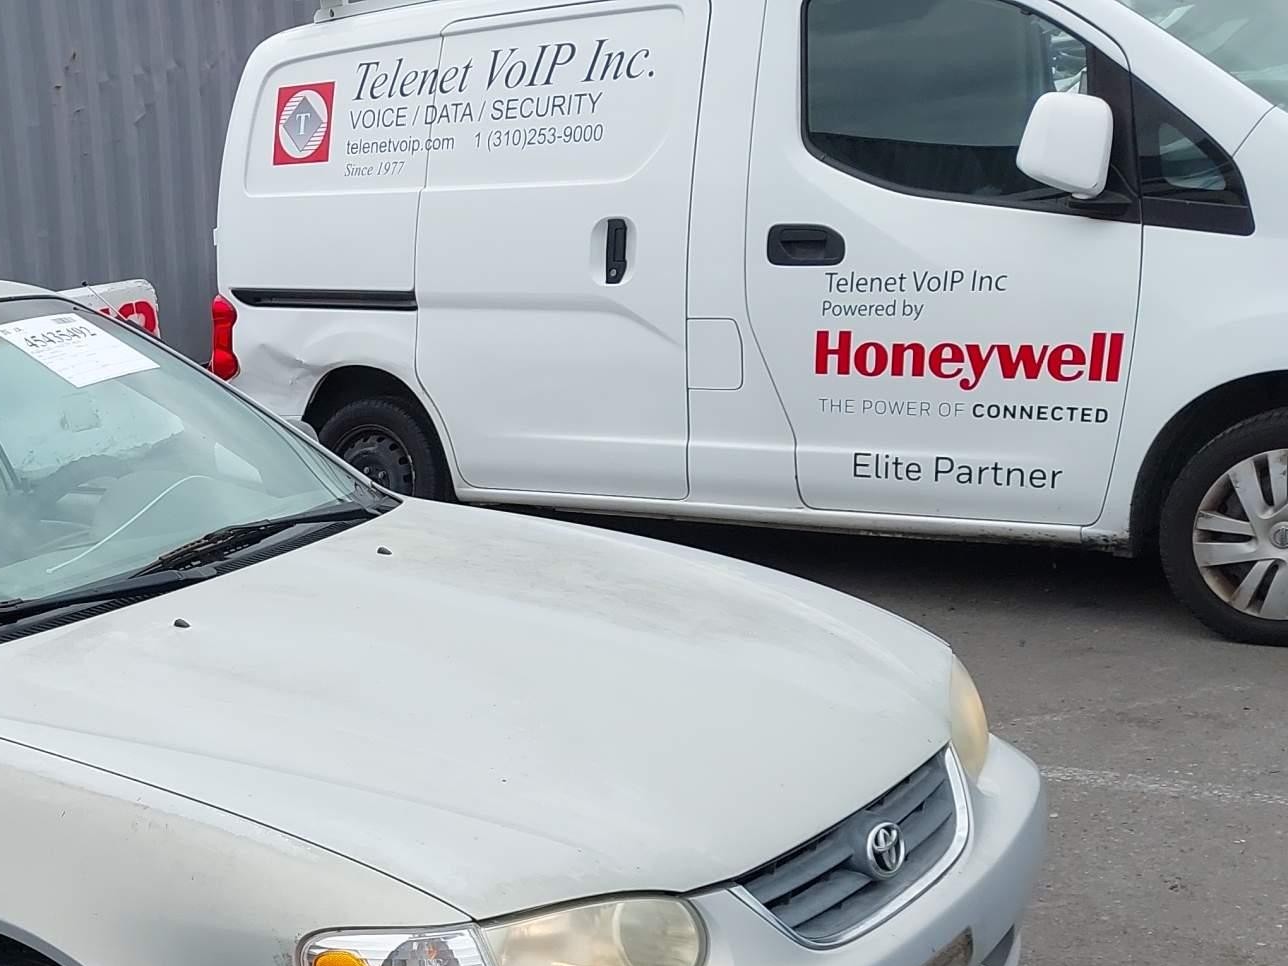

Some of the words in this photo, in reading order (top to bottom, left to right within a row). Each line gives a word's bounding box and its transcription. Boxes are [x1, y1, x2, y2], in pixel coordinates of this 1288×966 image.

[352, 58, 473, 100] Telenet
[486, 43, 576, 90] VoIP
[581, 39, 654, 83] Inc.
[350, 106, 408, 130] VOICE
[412, 105, 420, 126] /
[424, 102, 473, 125] DATA
[478, 101, 486, 122] /
[490, 92, 603, 121] SECURITY
[346, 136, 455, 156] telenetvoip.com
[487, 124, 604, 152] (310)253-9000
[344, 164, 373, 177] Since
[377, 161, 405, 176] 1977
[825, 272, 907, 293] Telenet
[913, 270, 964, 292] VoIP
[971, 269, 1008, 292] Inc
[822, 300, 896, 316] Powered
[902, 300, 924, 321] by
[815, 331, 1124, 390] Honeywell
[818, 398, 855, 414] THE
[862, 400, 931, 417] POWER
[938, 402, 965, 417] OF
[972, 403, 1109, 424] CONNECTED
[853, 452, 922, 481] Elite
[934, 456, 1063, 489] Partner
